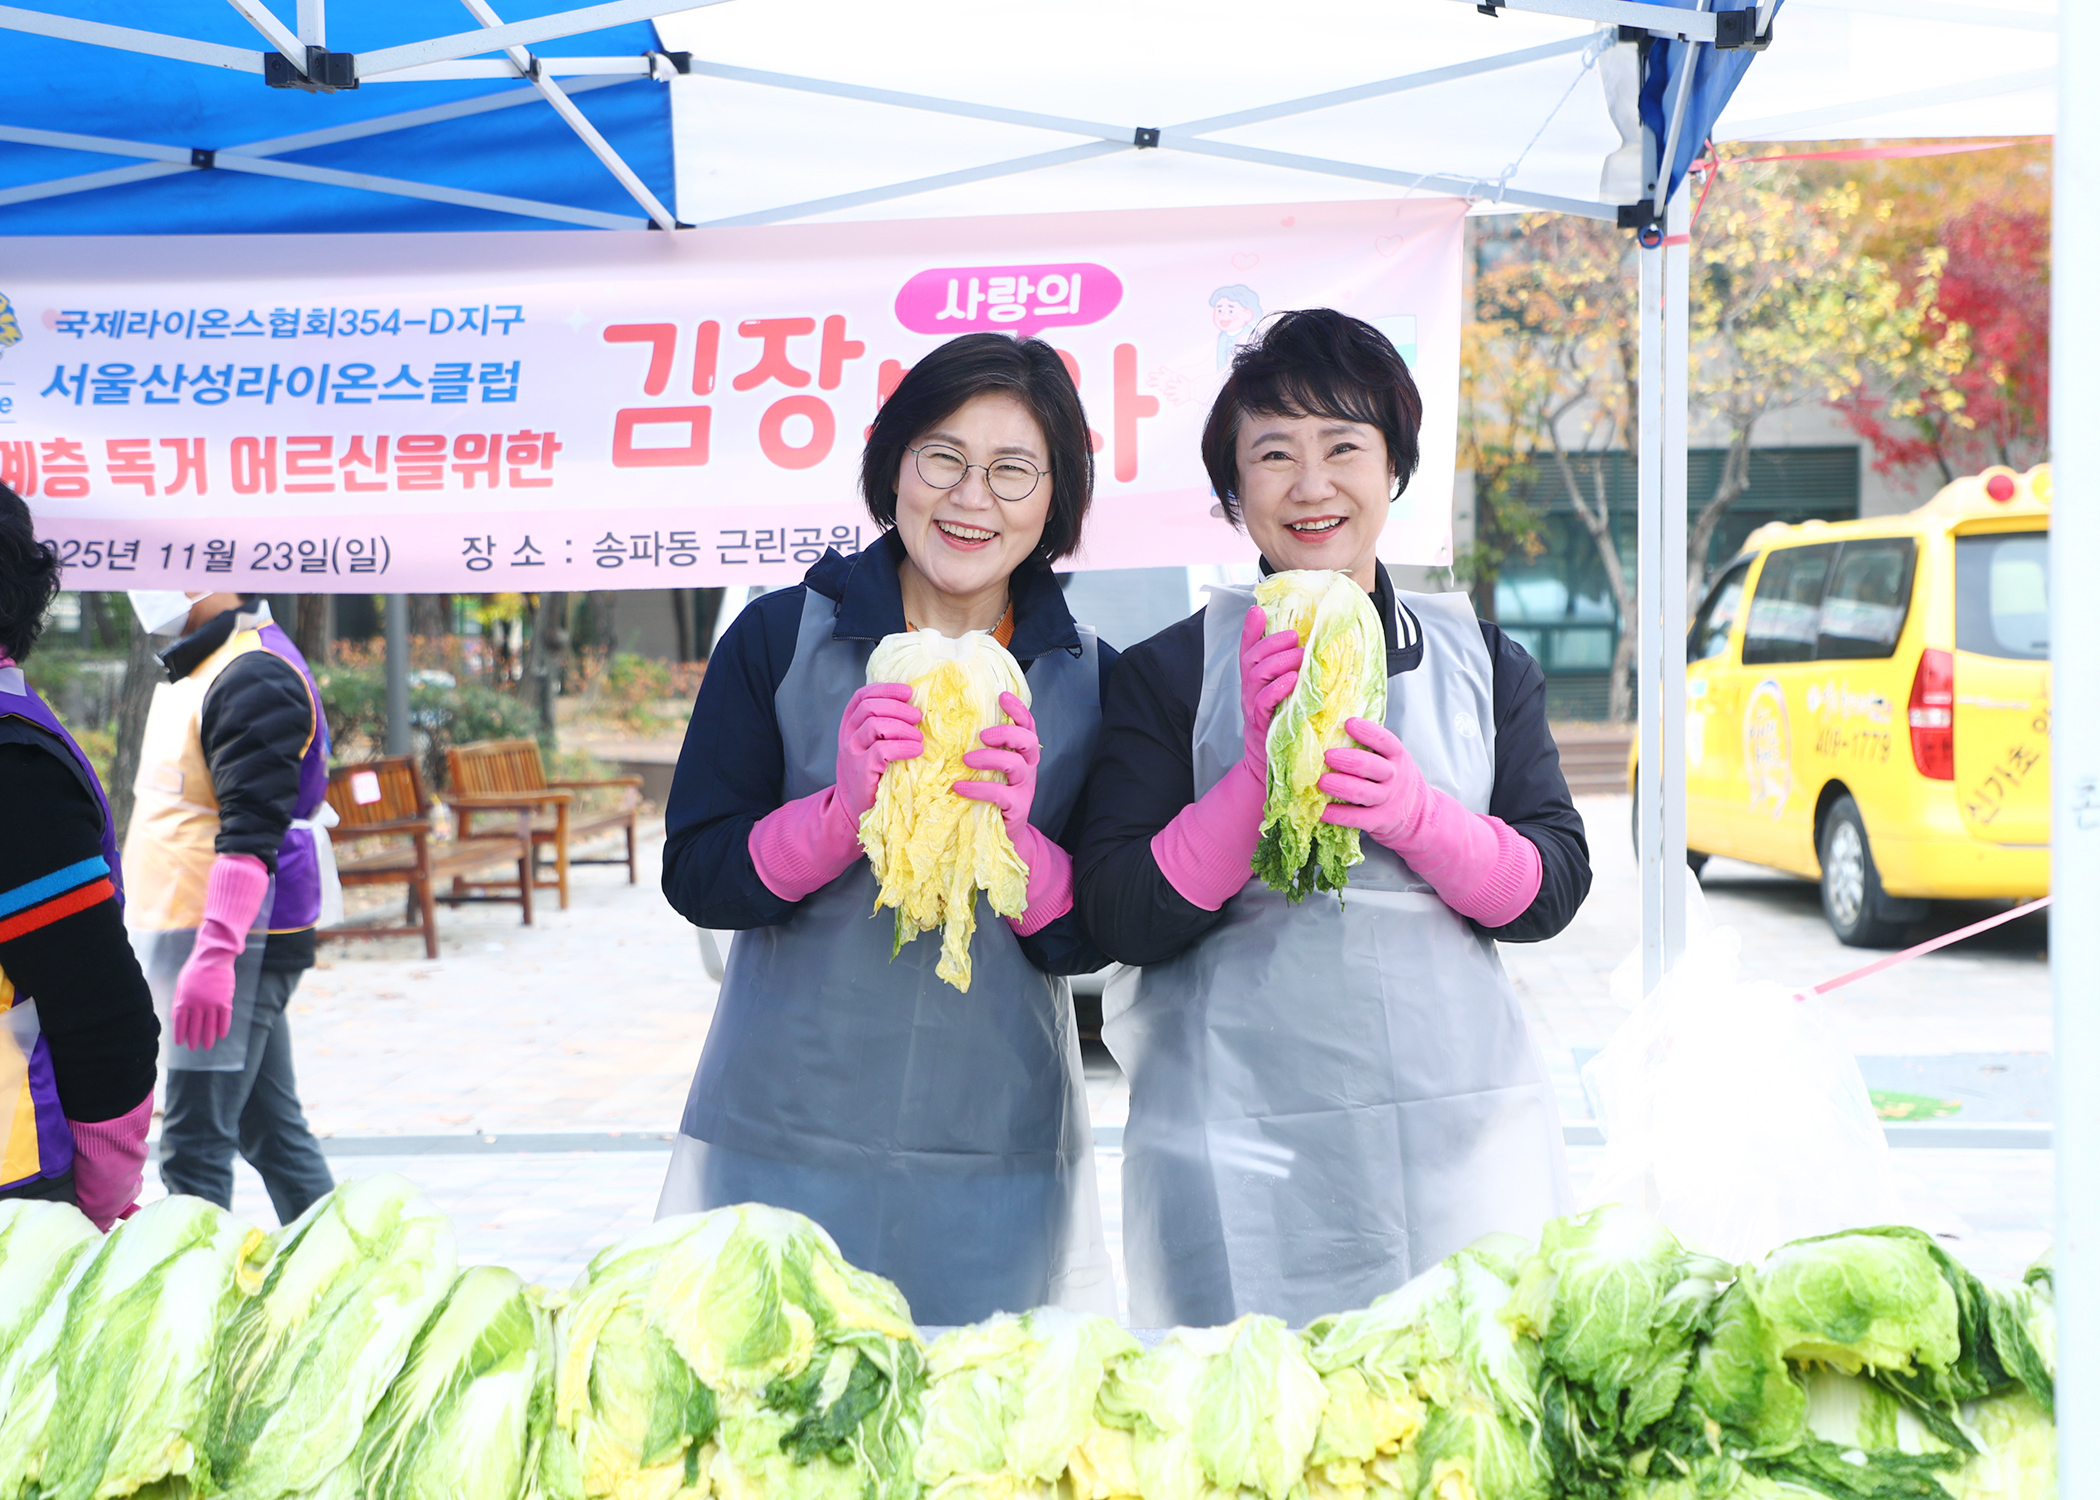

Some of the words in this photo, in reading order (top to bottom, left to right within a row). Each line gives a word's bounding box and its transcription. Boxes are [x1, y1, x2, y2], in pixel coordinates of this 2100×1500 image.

[935, 273, 1082, 323] 사랑의
[55, 304, 525, 340] 국제라이온스협회354-D지구
[40, 360, 521, 405] 서울산성라이온스클럽
[106, 437, 208, 496] 독거
[230, 428, 562, 495] 어르신을위한
[161, 540, 235, 572] 11월
[250, 536, 391, 575] 23일(일)
[592, 531, 701, 568] 송파동
[716, 525, 861, 564] 근린공원
